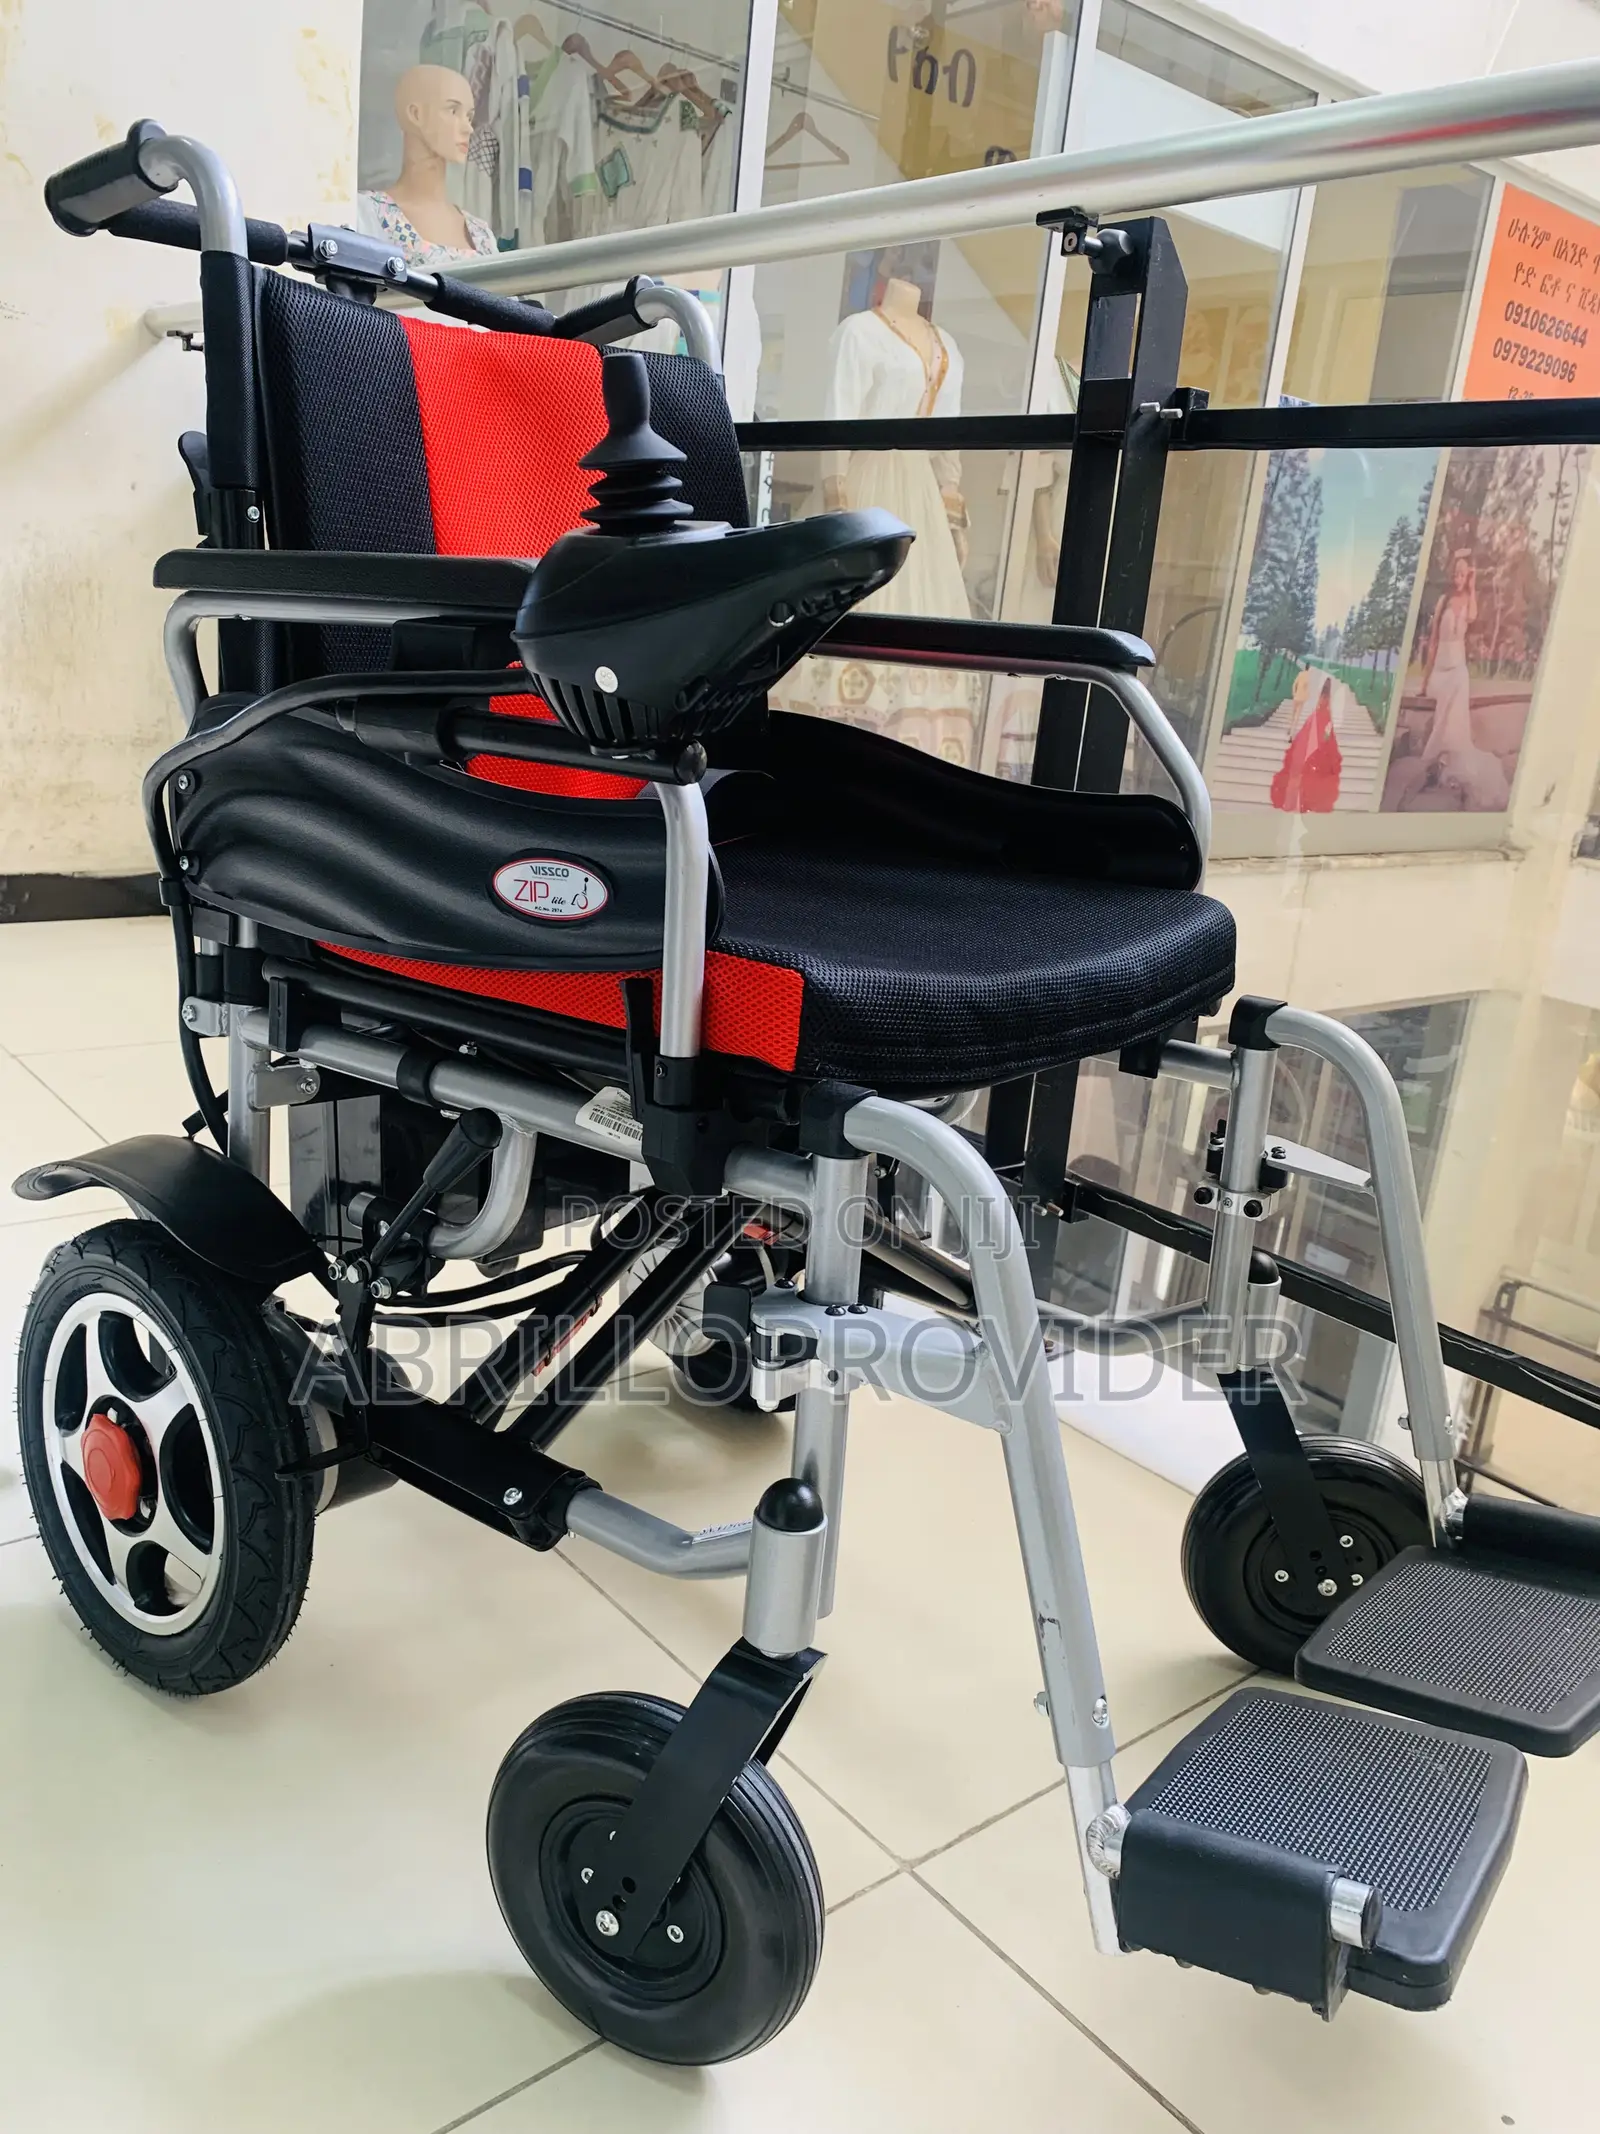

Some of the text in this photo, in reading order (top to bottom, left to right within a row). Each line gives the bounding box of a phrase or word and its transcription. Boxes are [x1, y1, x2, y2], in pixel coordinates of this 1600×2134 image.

[1504, 299, 1589, 349] 0910626644
[1492, 336, 1578, 384] 0979229096
[530, 865, 570, 878] VISSCO
[513, 879, 567, 905] ZIP lite
